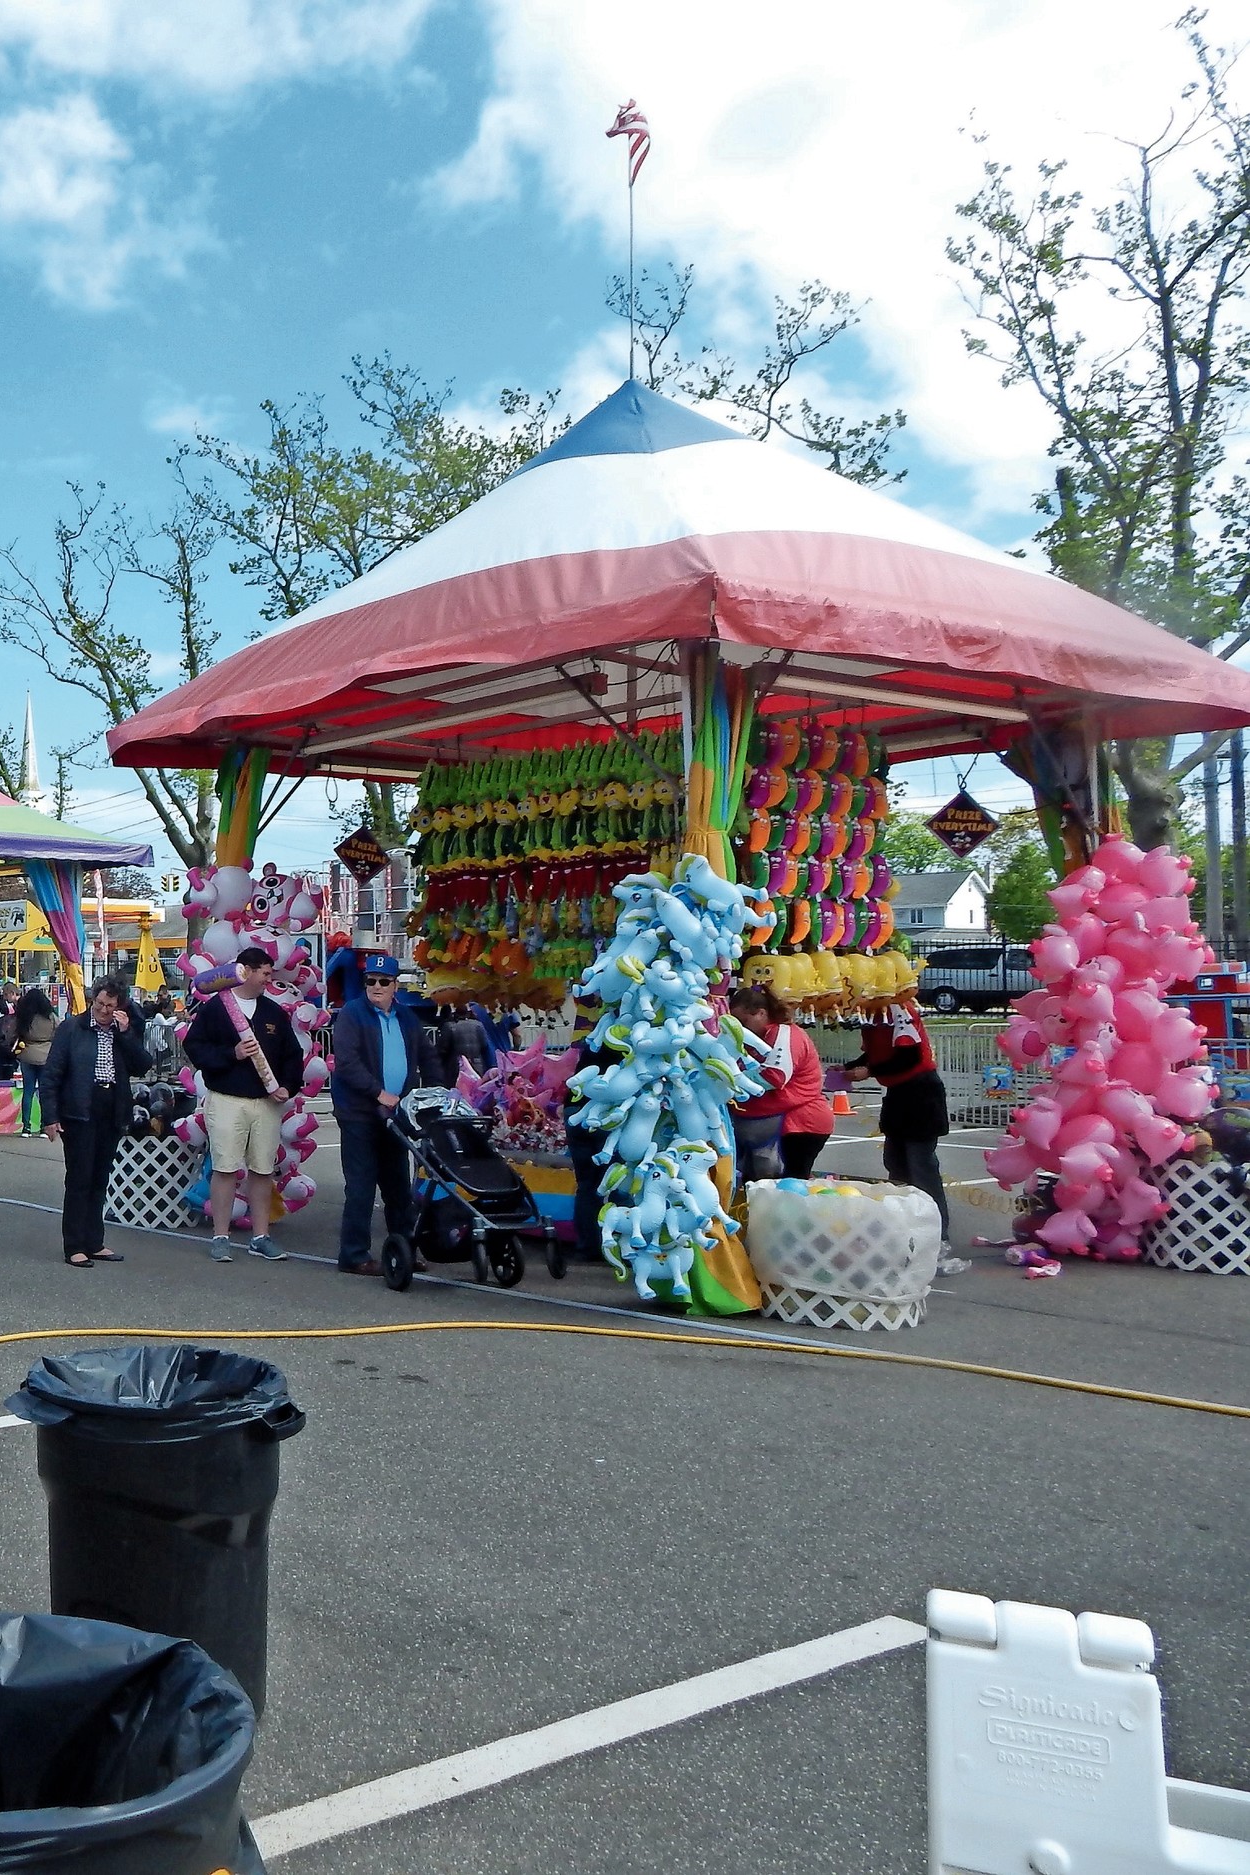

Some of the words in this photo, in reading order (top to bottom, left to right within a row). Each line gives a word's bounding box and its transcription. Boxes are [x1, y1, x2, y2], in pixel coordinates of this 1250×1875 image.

[946, 808, 982, 820] PRIZE
[932, 821, 994, 832] EVERYTIME
[351, 838, 378, 852] PRIZE
[376, 957, 385, 967] B
[978, 1685, 1113, 1726] Signicade
